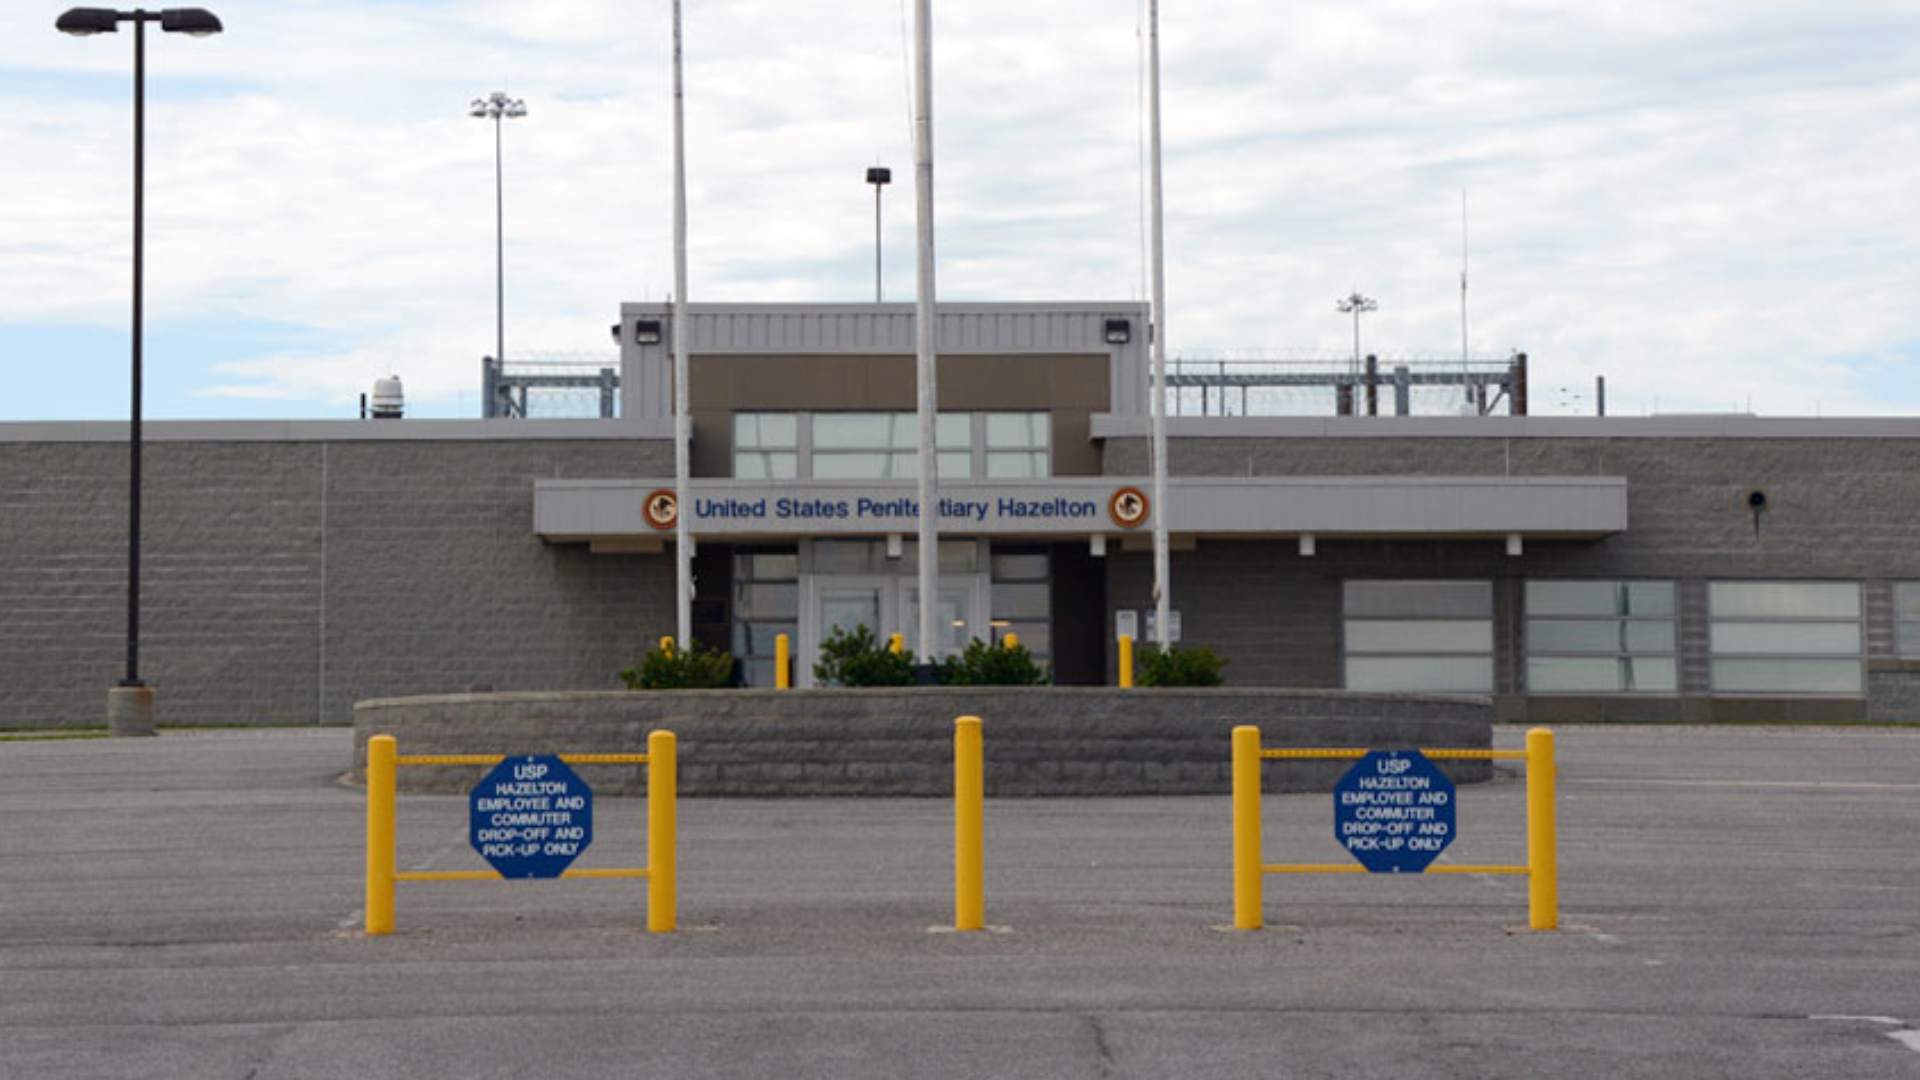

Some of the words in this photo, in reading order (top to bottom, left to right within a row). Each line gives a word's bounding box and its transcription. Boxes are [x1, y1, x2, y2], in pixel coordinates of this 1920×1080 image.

[696, 498, 766, 518] United
[776, 497, 849, 518] States
[857, 498, 988, 520] Penitetiary
[998, 497, 1096, 518] Hazelton
[514, 764, 548, 780] USP
[1377, 759, 1412, 774] USP
[495, 781, 567, 795] HAZELTON
[1359, 776, 1430, 790] HAZELTON
[477, 797, 550, 812] EMPLOYEE
[555, 796, 584, 810] AND
[1341, 791, 1414, 805] EMPLOYEE
[1418, 791, 1448, 805] AND
[491, 812, 571, 826] COMMUTER
[1355, 806, 1435, 820] COMMUTER
[478, 827, 550, 842] DROP-OFF
[555, 826, 584, 840] AND
[1342, 822, 1414, 836] DROP-OFF
[1418, 822, 1448, 836] AND
[482, 842, 541, 857] PICK-UP
[544, 842, 579, 856] ONLY
[1347, 836, 1405, 850] PICK-UP
[1408, 836, 1443, 850] ONLY
